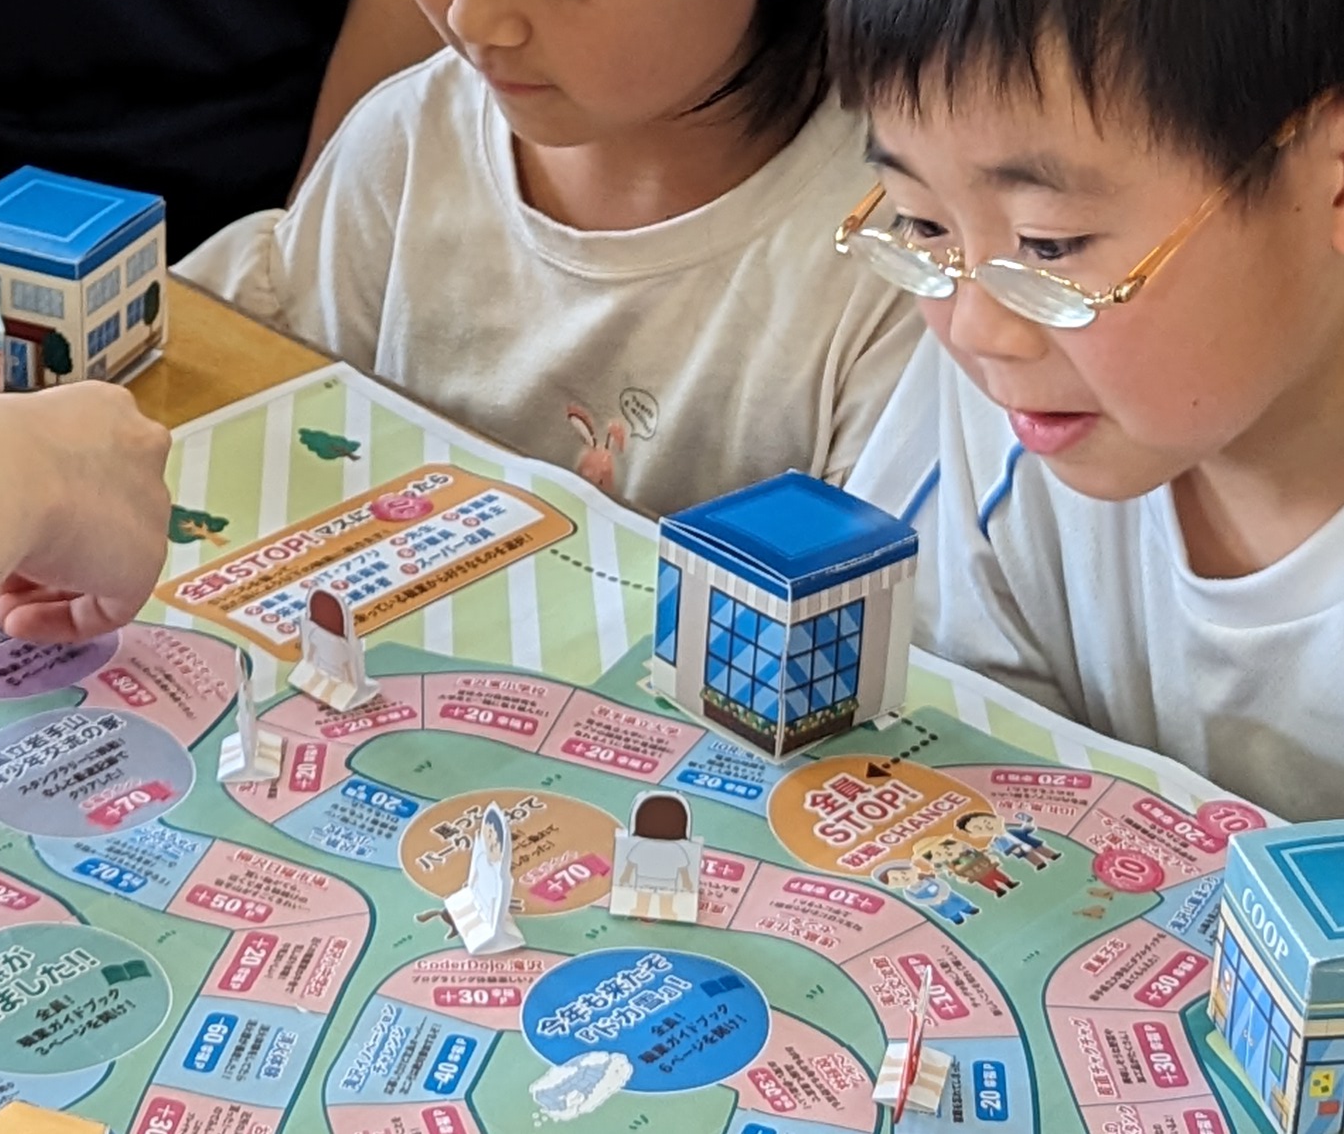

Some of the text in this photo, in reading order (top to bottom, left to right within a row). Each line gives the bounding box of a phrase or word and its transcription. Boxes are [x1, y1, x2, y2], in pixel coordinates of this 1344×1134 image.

[453, 707, 493, 724] +20
[570, 742, 616, 762] +20
[806, 773, 872, 817] 全員
[1038, 774, 1084, 787] +20
[104, 791, 152, 819] +70
[370, 791, 410, 811] -20
[813, 779, 923, 846] STOP!
[879, 791, 971, 847] CHANCE
[1210, 808, 1251, 835] 10
[1176, 821, 1216, 848] +20
[546, 866, 591, 892] +70
[1110, 859, 1149, 882] 10
[195, 891, 242, 913] +50
[830, 890, 874, 911] +10
[1242, 887, 1289, 962] COOP
[239, 937, 268, 969] +20
[440, 989, 489, 1005] +30
[537, 953, 673, 1038] 今年も来たぞ
[1147, 974, 1177, 1004] +30
[17, 988, 121, 1048] 職業ガイドブック
[205, 1018, 230, 1044] -60
[637, 1003, 729, 1064] 職業ガイドブック
[373, 1025, 407, 1077] チャレンジ
[1069, 1017, 1118, 1098] 産直チャグチャグ
[432, 1061, 459, 1091] -40
[1150, 1053, 1175, 1084] +30
[756, 1069, 783, 1098] +30
[981, 1089, 1001, 1119] -20
